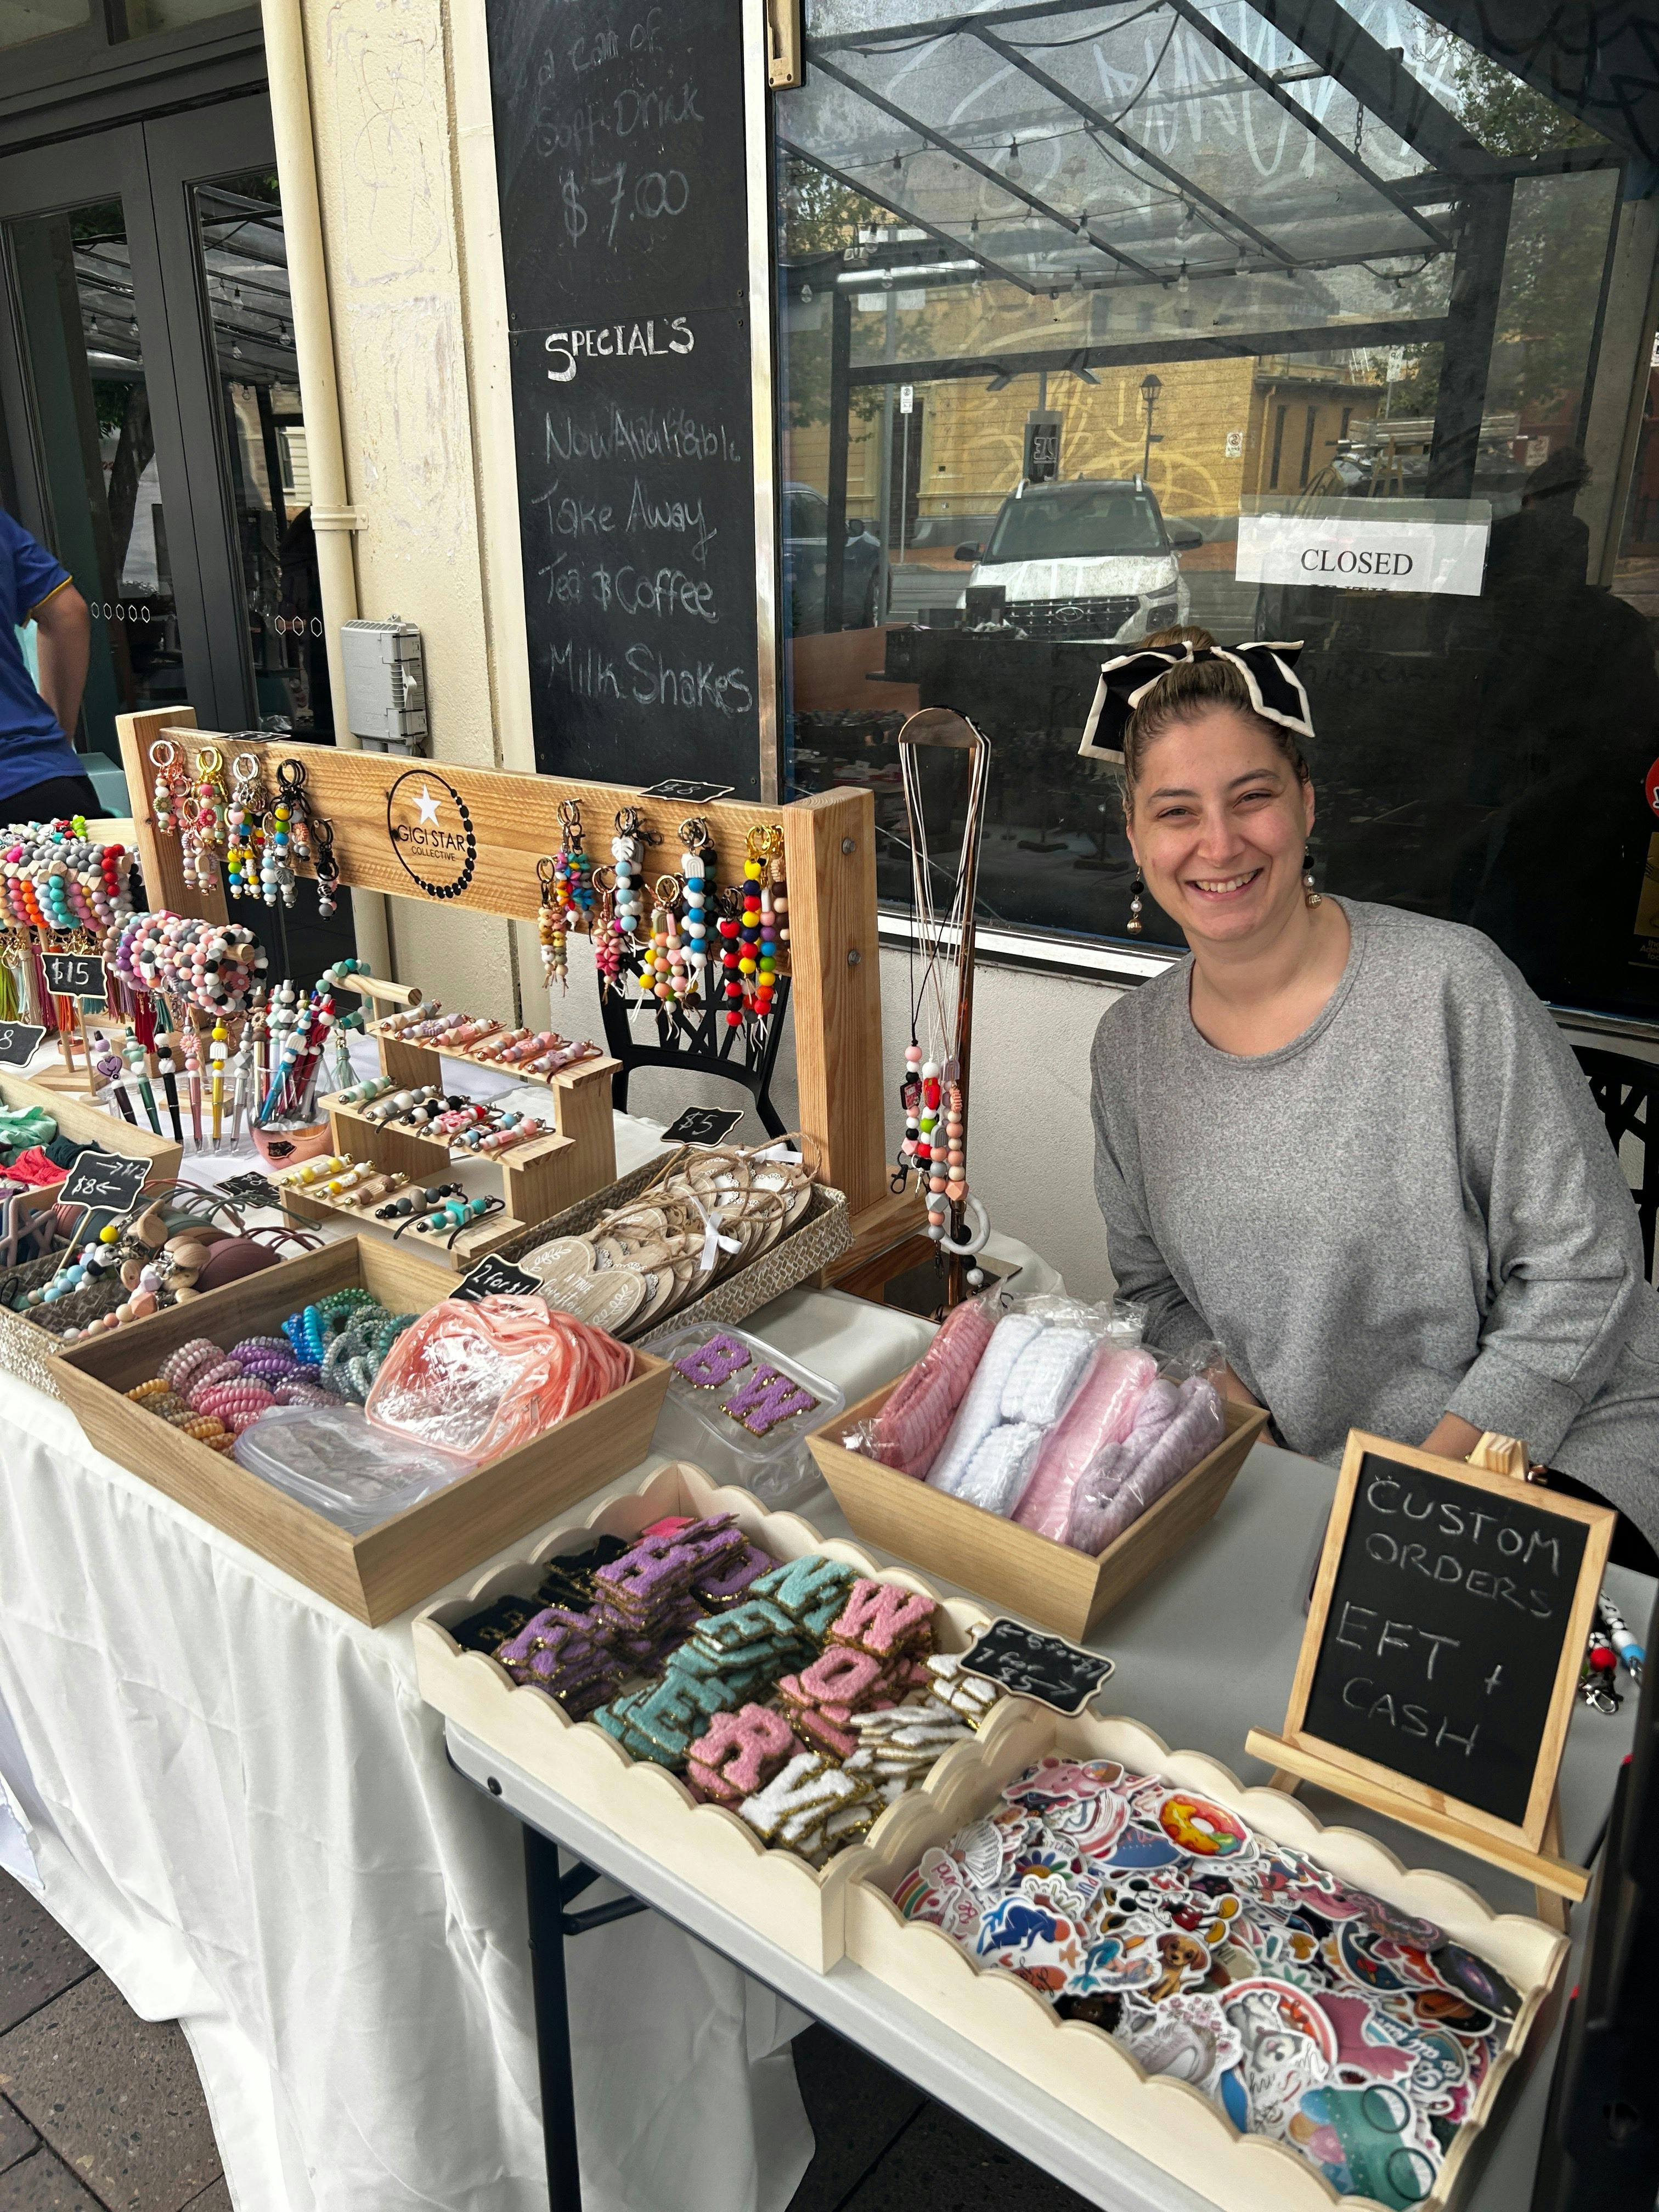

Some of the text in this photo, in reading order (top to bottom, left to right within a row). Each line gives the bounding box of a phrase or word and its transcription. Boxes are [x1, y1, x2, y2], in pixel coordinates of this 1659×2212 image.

[614, 82, 705, 137] Drink
[562, 162, 689, 249] $7.00
[531, 476, 718, 570] Take Away
[538, 551, 582, 604] Tea
[614, 565, 720, 624] Coffee
[1301, 549, 1413, 576] CLOSED
[548, 640, 753, 719] Milk Shakes
[397, 824, 466, 852] GIGI STAR
[411, 845, 456, 862] COLLECTIVE
[52, 957, 89, 985] $15
[678, 1111, 719, 1136] $5
[71, 1175, 97, 1196] $8
[483, 1271, 511, 1289] for
[572, 1277, 595, 1294] TRUE
[1367, 1480, 1560, 1576] CUSTOM
[1365, 1533, 1553, 1618] ORDERS
[1335, 1601, 1460, 1680] EFT
[1342, 1677, 1480, 1756] CASH
